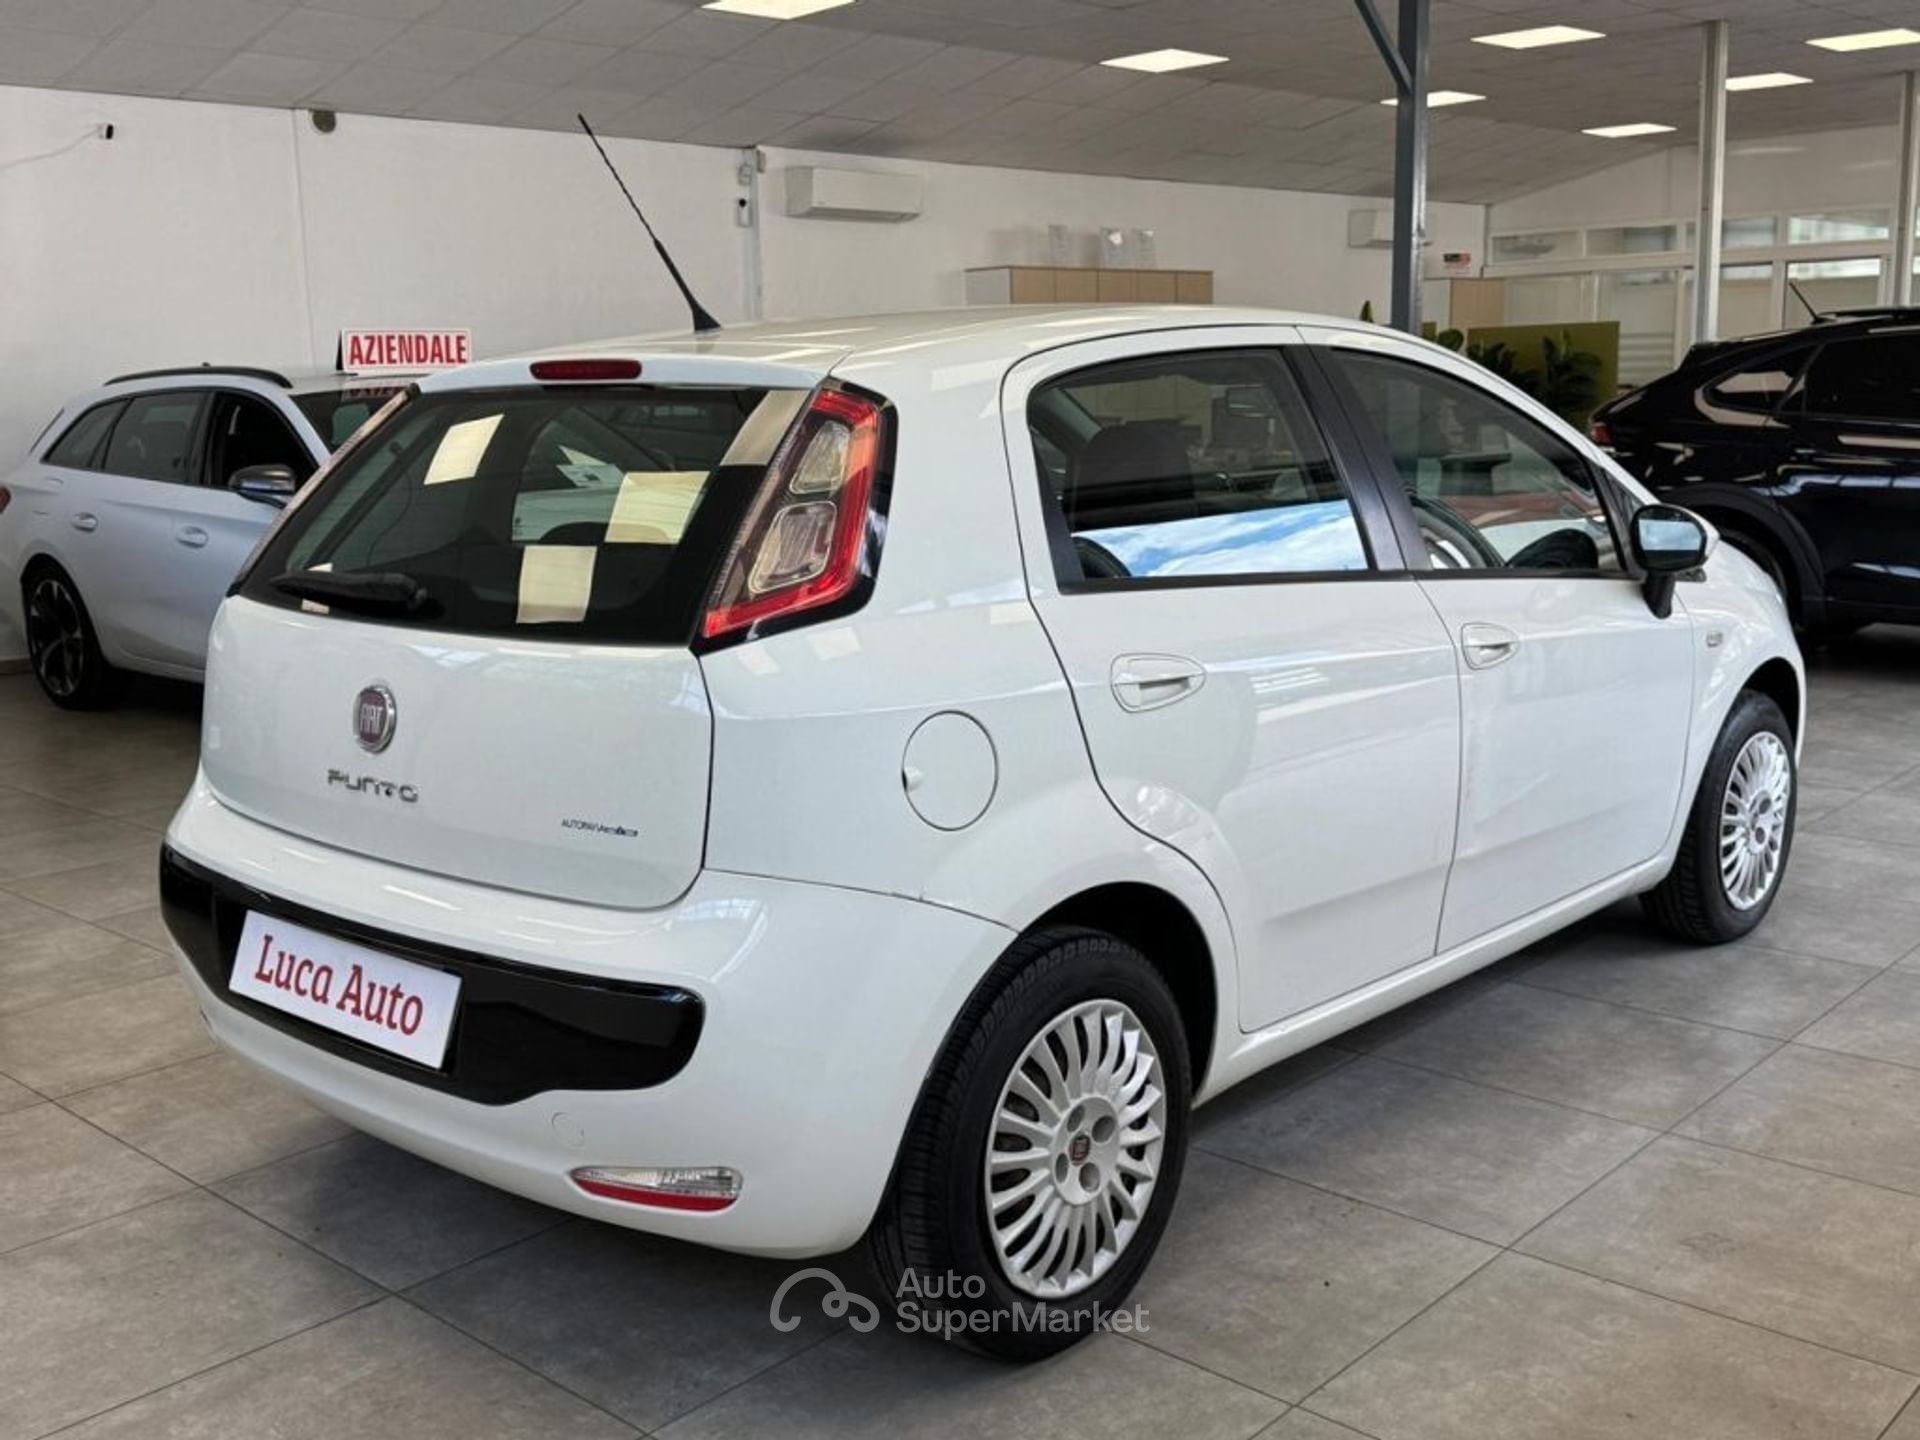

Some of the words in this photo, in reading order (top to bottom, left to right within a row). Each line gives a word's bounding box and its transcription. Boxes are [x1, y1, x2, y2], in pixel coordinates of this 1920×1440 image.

[349, 334, 468, 365] AZIENDALE
[327, 768, 420, 803] PUNTO
[255, 934, 334, 1004] Luca
[335, 964, 424, 1036] Auto
